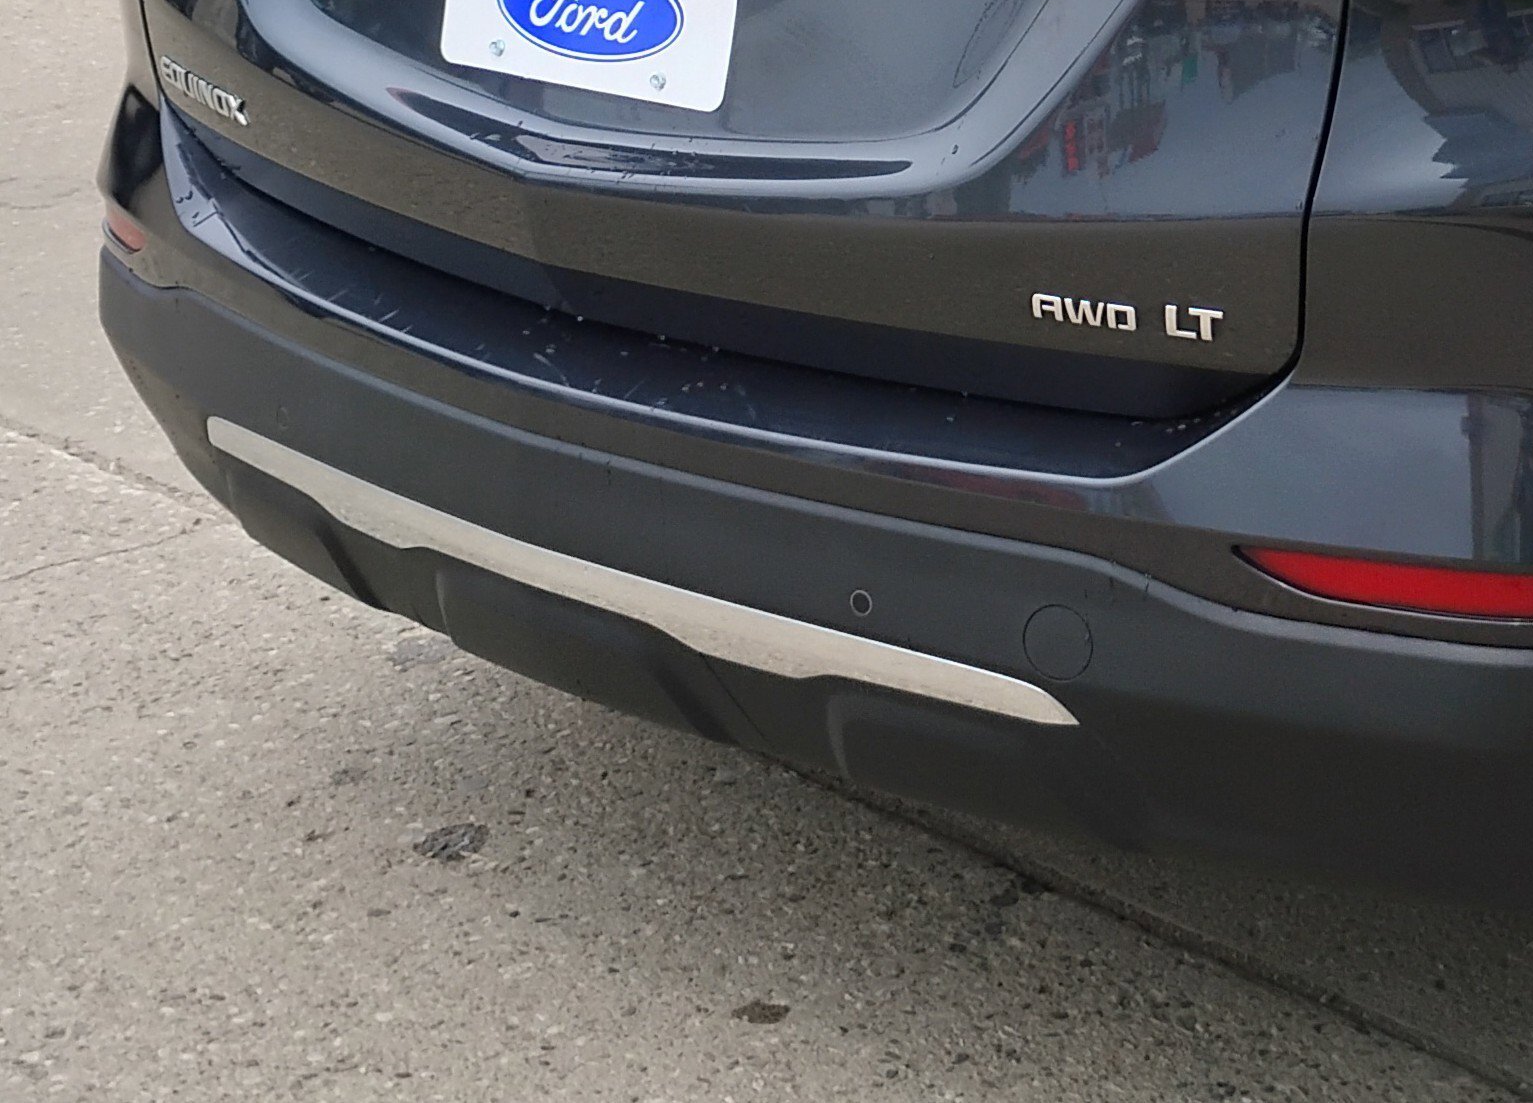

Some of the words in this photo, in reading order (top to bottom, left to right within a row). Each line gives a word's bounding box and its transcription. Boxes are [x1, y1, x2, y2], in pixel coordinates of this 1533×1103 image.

[161, 55, 249, 127] EQUINOX
[1031, 292, 1138, 333] AWD
[1164, 303, 1225, 342] LT
